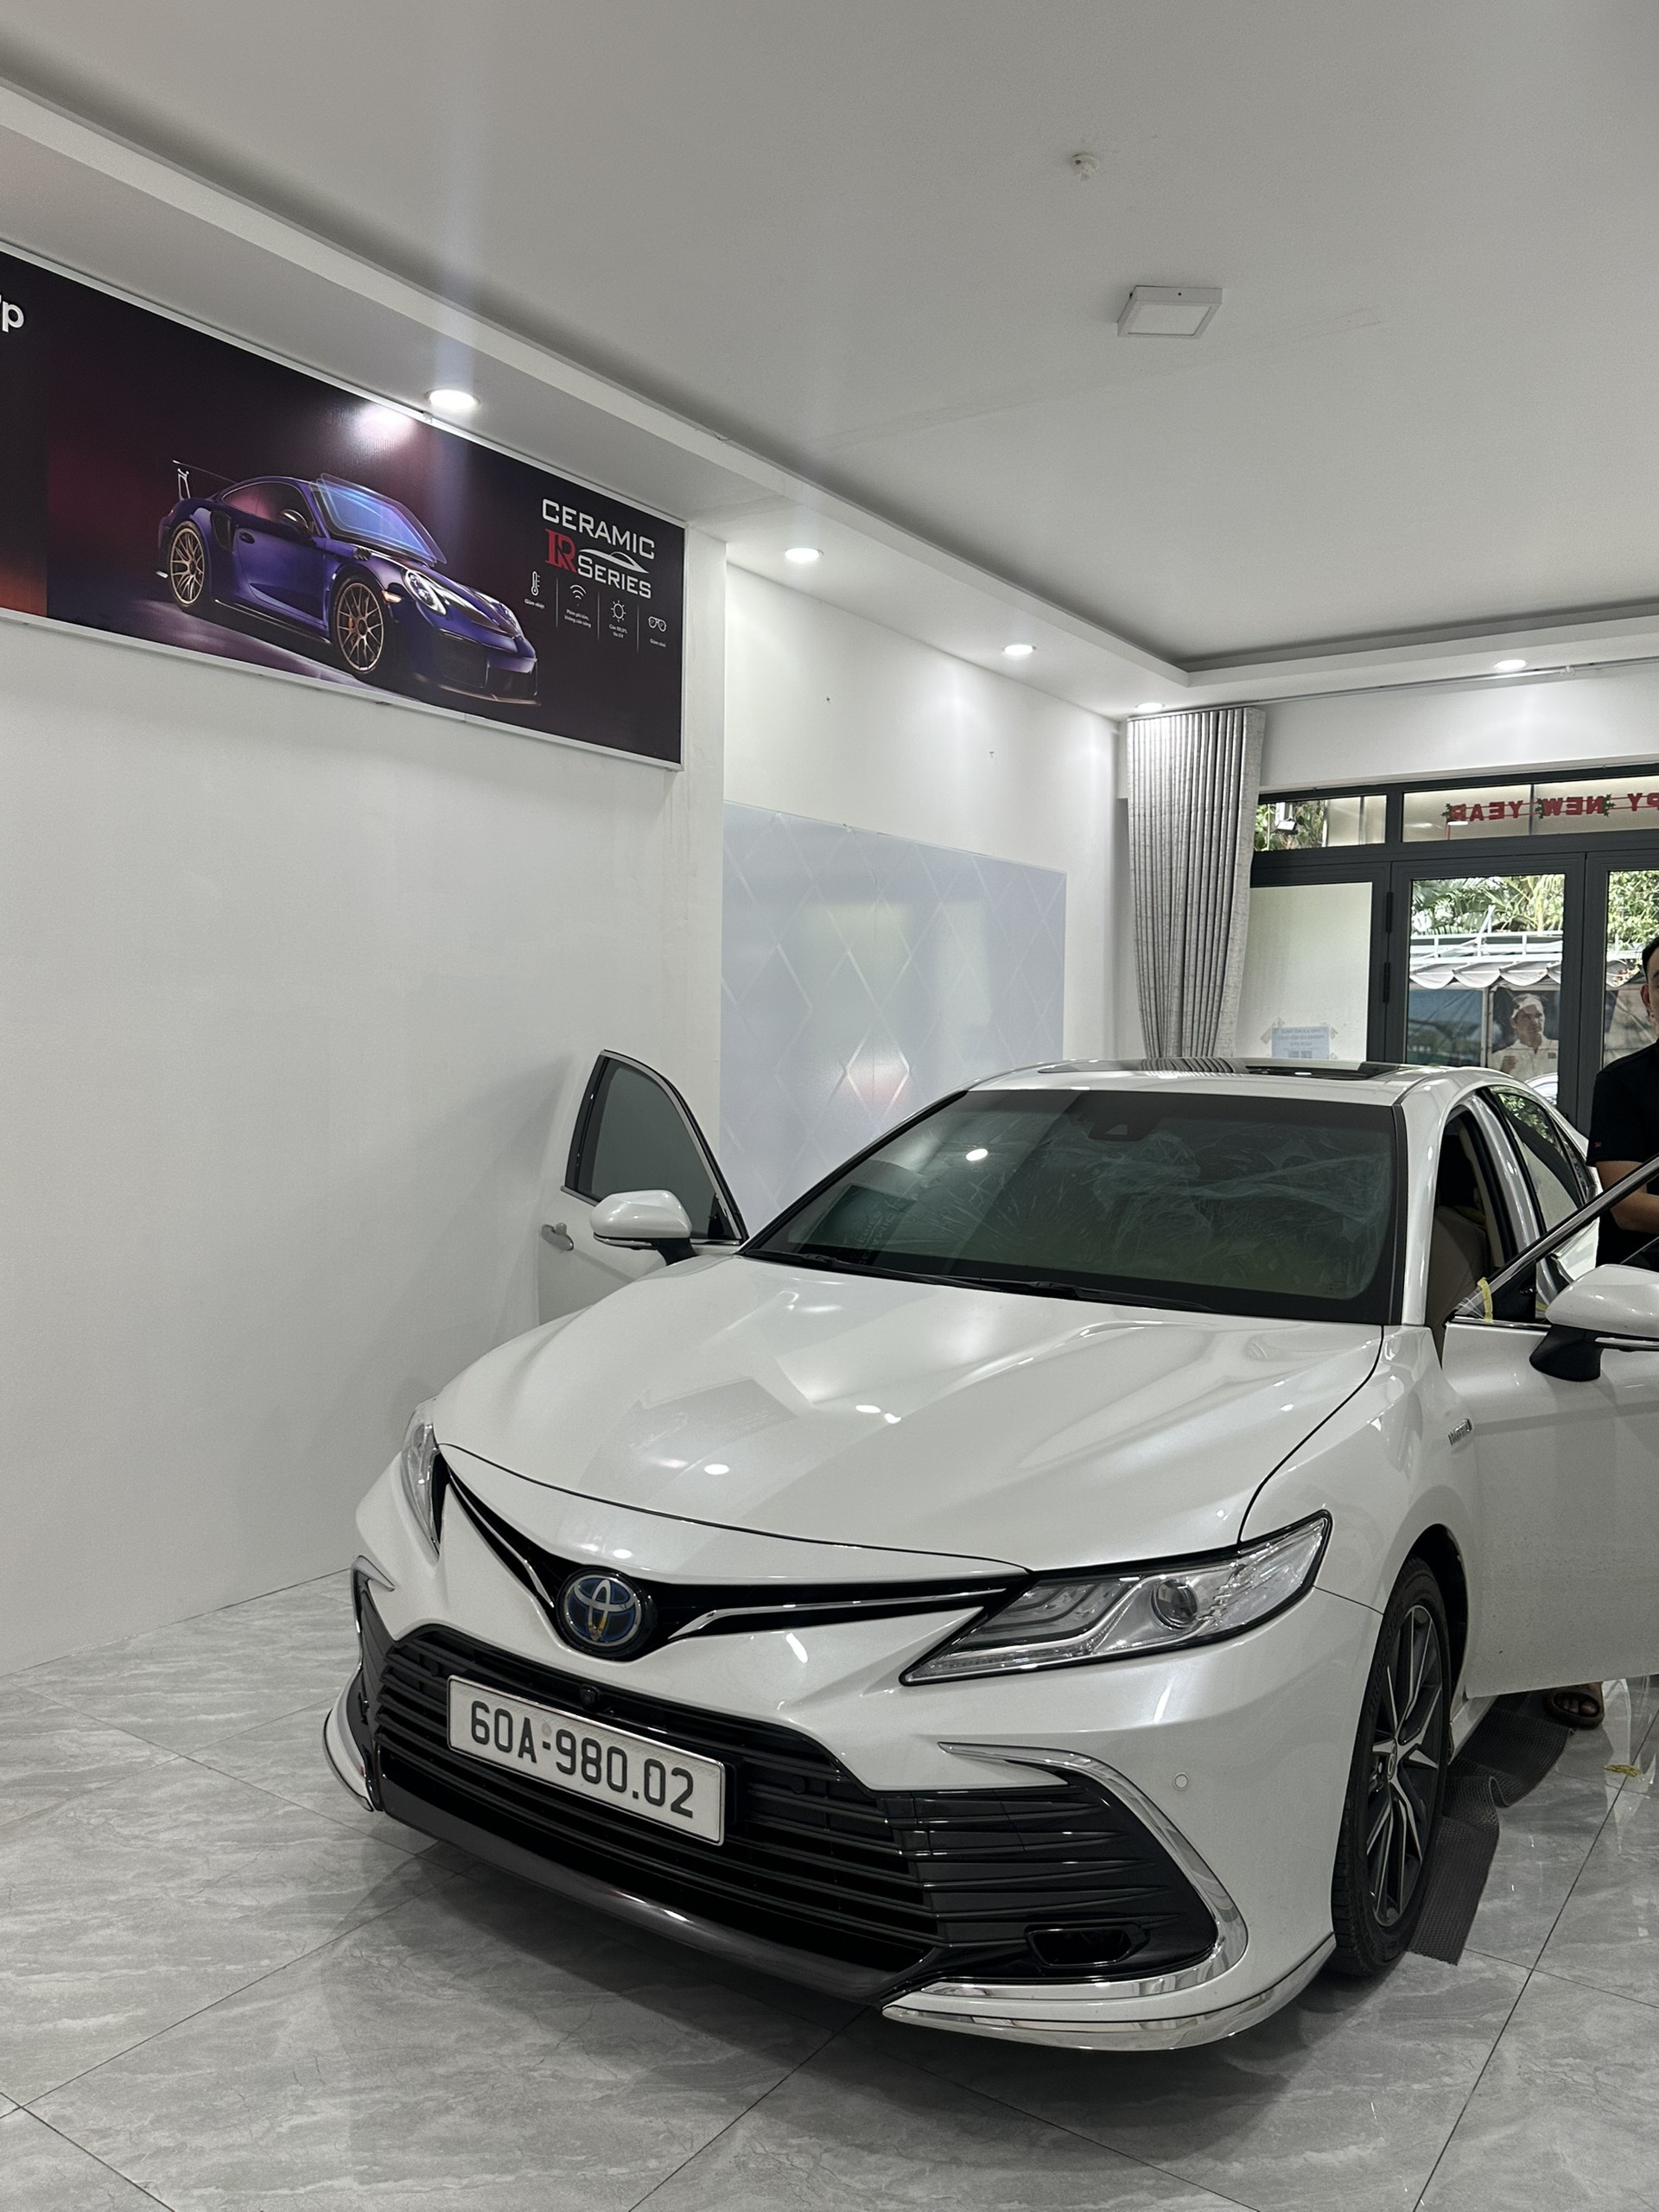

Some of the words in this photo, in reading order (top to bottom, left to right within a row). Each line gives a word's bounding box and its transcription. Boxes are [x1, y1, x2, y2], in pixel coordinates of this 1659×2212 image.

[542, 498, 655, 560] CERAMIC
[577, 555, 652, 600] SERIES
[470, 1700, 694, 1819] 60A-980.02
